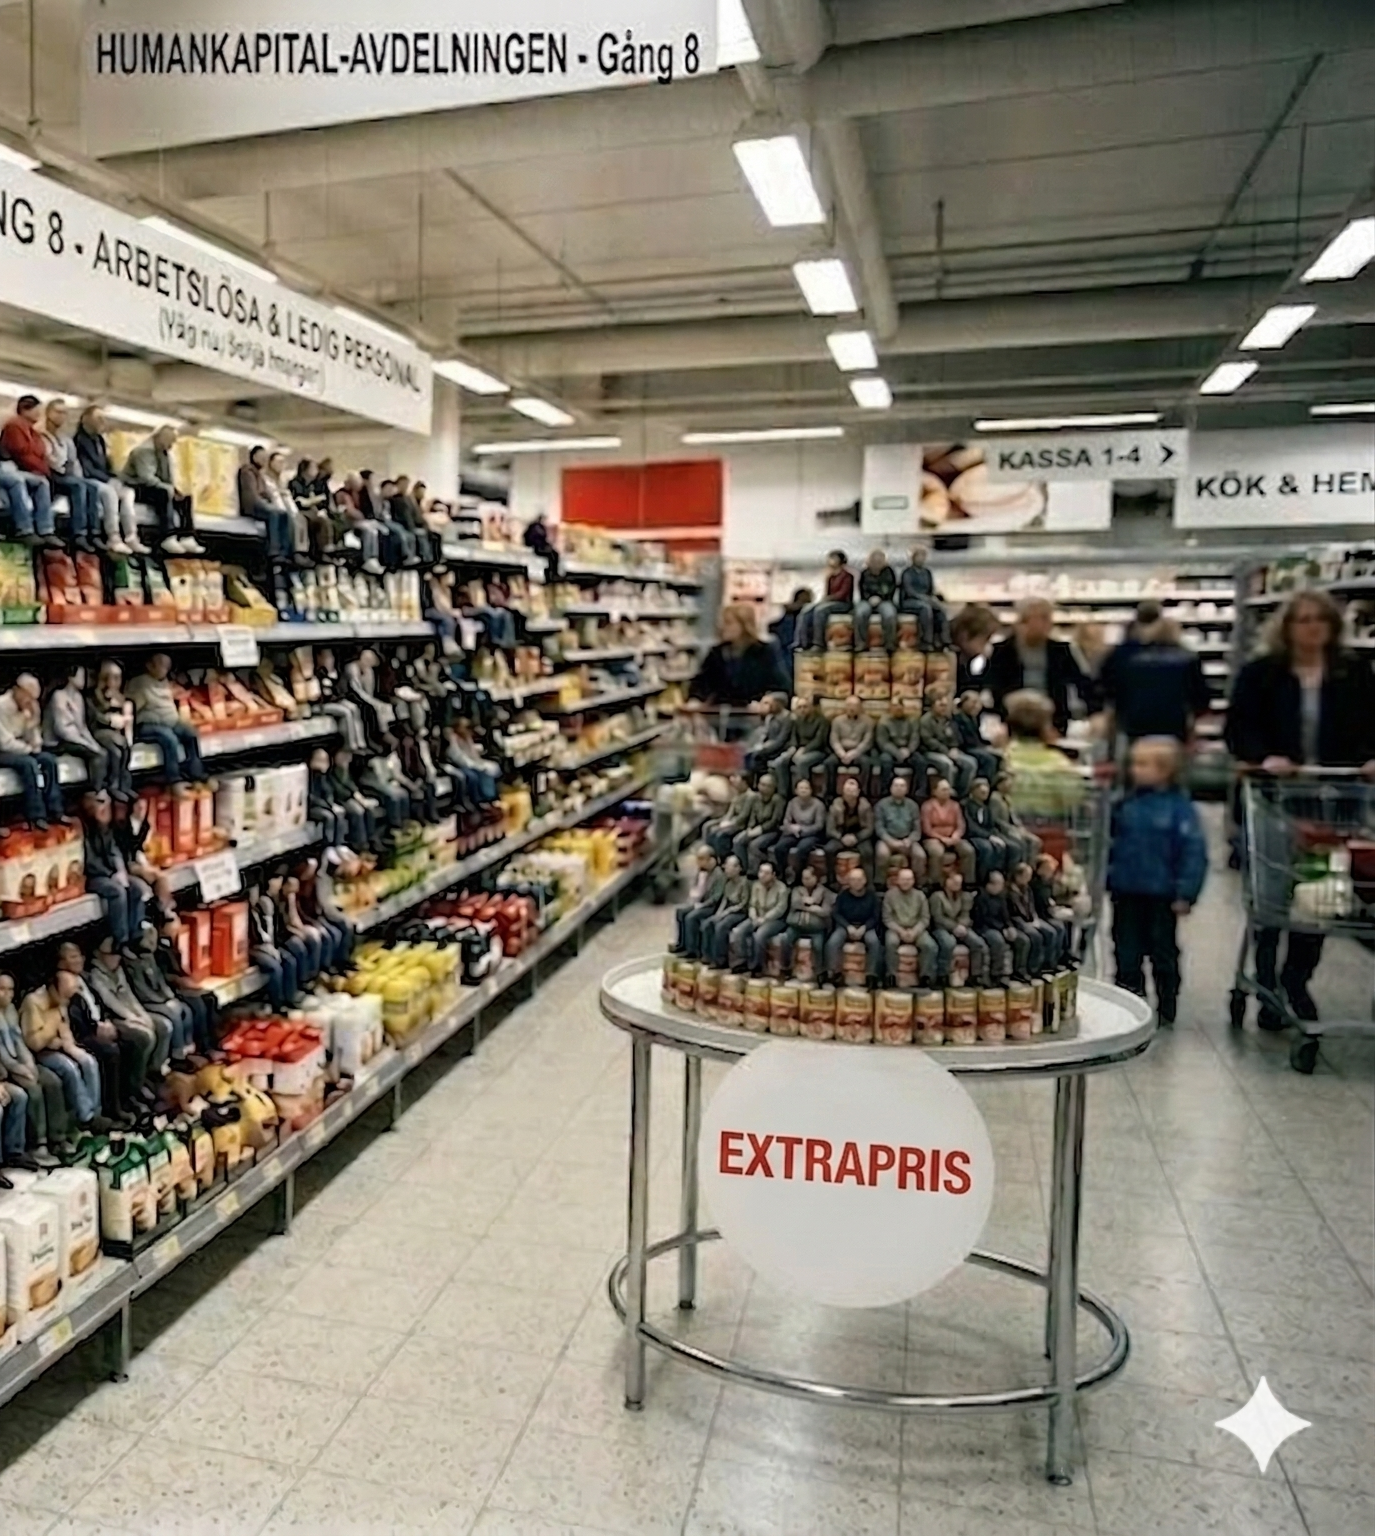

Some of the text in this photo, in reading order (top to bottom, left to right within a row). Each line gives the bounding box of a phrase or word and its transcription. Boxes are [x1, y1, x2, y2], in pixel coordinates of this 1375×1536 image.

[96, 32, 567, 75] HUMANKAPITAL-AVDELNINGEN
[597, 30, 674, 84] Gång
[683, 32, 700, 75] 8
[47, 211, 65, 255] 8
[92, 231, 263, 333] ARBETSLÖSA
[267, 303, 281, 337] &
[286, 310, 339, 361] LEDIG
[344, 334, 421, 393] PERSONAL
[999, 446, 1143, 471] KASSA 1-4
[1195, 471, 1266, 499] KÖK
[1277, 475, 1299, 496] &
[719, 1129, 972, 1195] EXTRAPRIS
